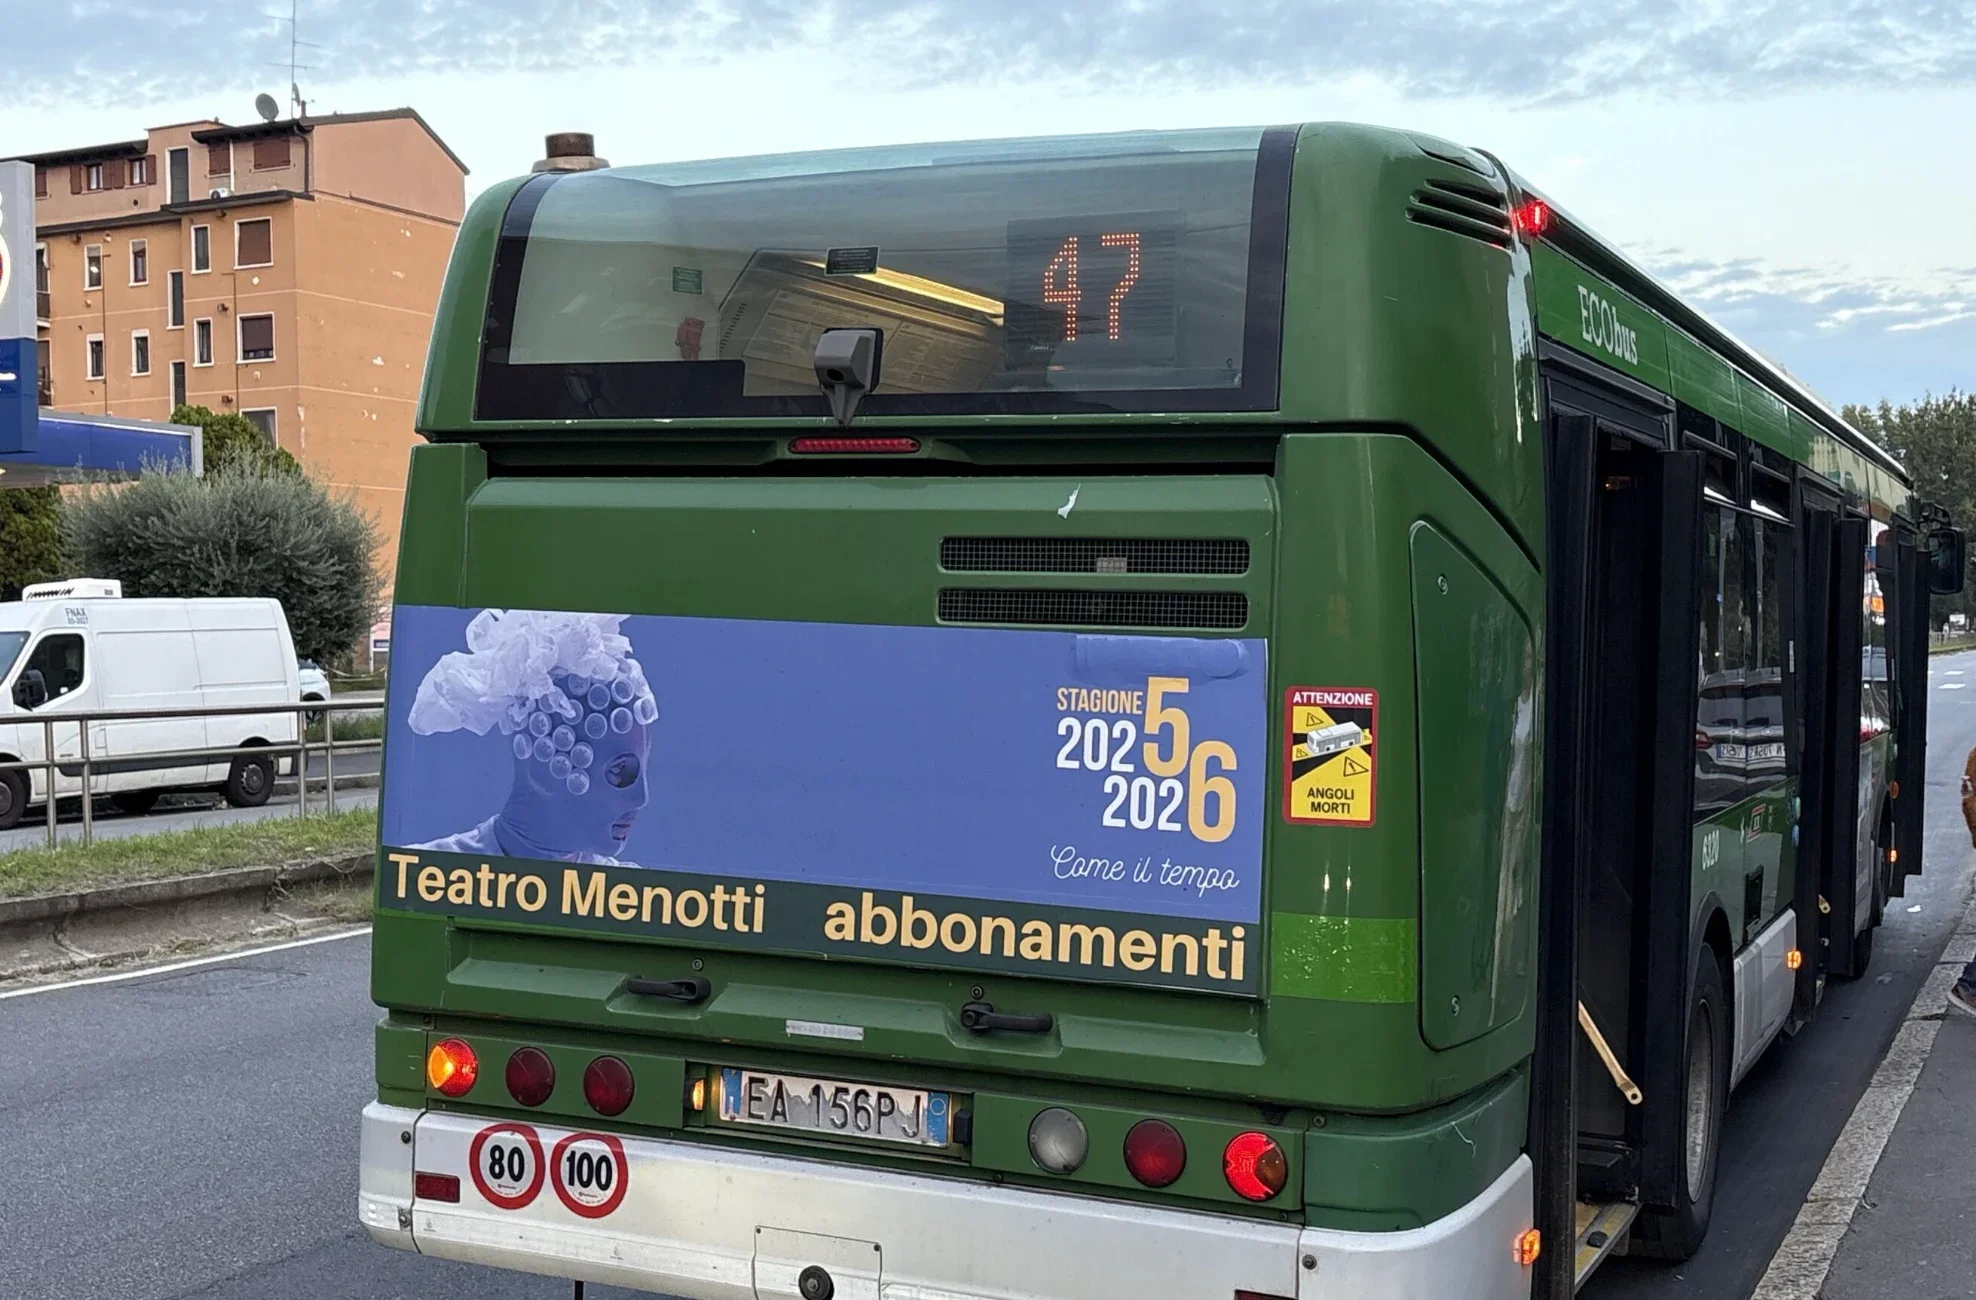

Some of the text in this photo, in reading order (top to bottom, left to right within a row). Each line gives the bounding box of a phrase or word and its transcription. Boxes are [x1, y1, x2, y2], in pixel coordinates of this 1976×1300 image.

[1044, 232, 1140, 342] 47
[1577, 283, 1638, 366] ECObus
[65, 608, 87, 616] FNAX
[1056, 687, 1144, 716] STAGIONE
[1292, 690, 1374, 707] ATTENZIONE
[1306, 786, 1355, 801] ANGOLI
[1310, 800, 1351, 815] MORTI
[1702, 829, 1720, 871] 6320
[1050, 845, 1241, 899] Come il tempo
[388, 852, 1247, 981] Teatro Menotti abbonamenti
[747, 1076, 788, 1123] EA
[809, 1083, 922, 1139] 156PJ
[489, 1144, 525, 1183] 80
[566, 1150, 613, 1192] 100
